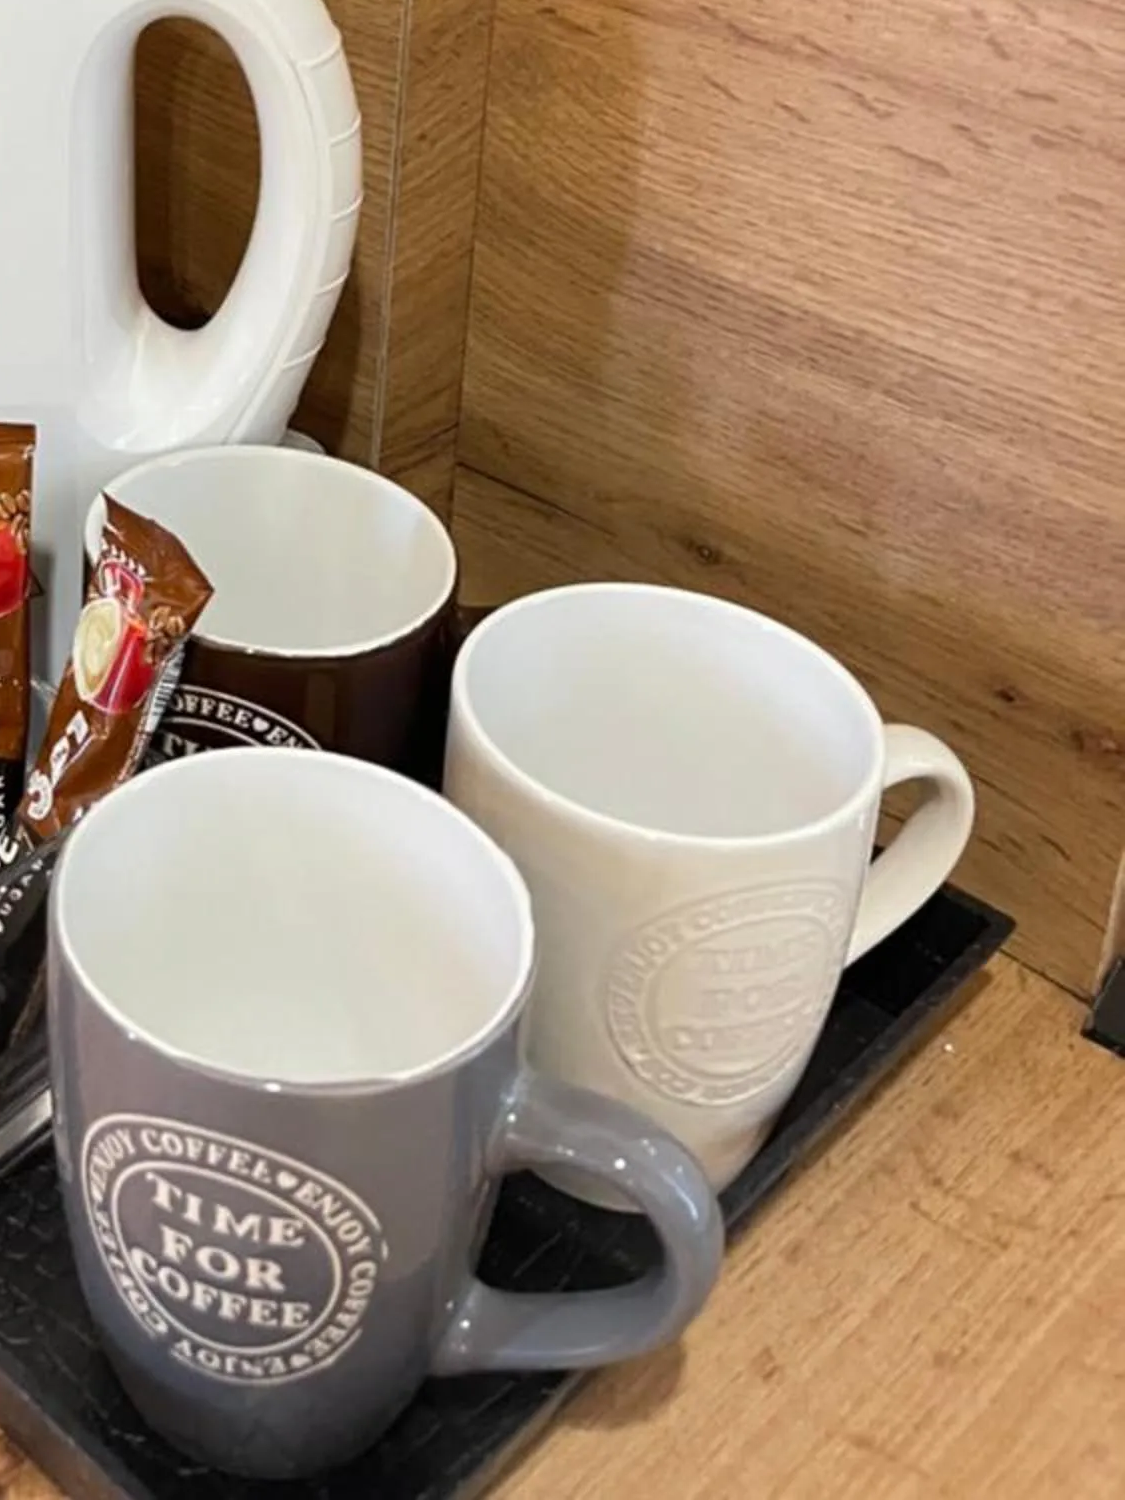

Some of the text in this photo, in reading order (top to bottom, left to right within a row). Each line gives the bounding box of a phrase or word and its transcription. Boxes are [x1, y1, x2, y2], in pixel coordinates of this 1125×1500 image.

[171, 691, 250, 730] OFFEE
[89, 1128, 136, 1190] ENJOY
[140, 1128, 273, 1185] COFFEE
[293, 1179, 372, 1255] ENJOY
[144, 1171, 306, 1247] TIME
[131, 1247, 312, 1329] COFFEE
[160, 1223, 285, 1292] FOR
